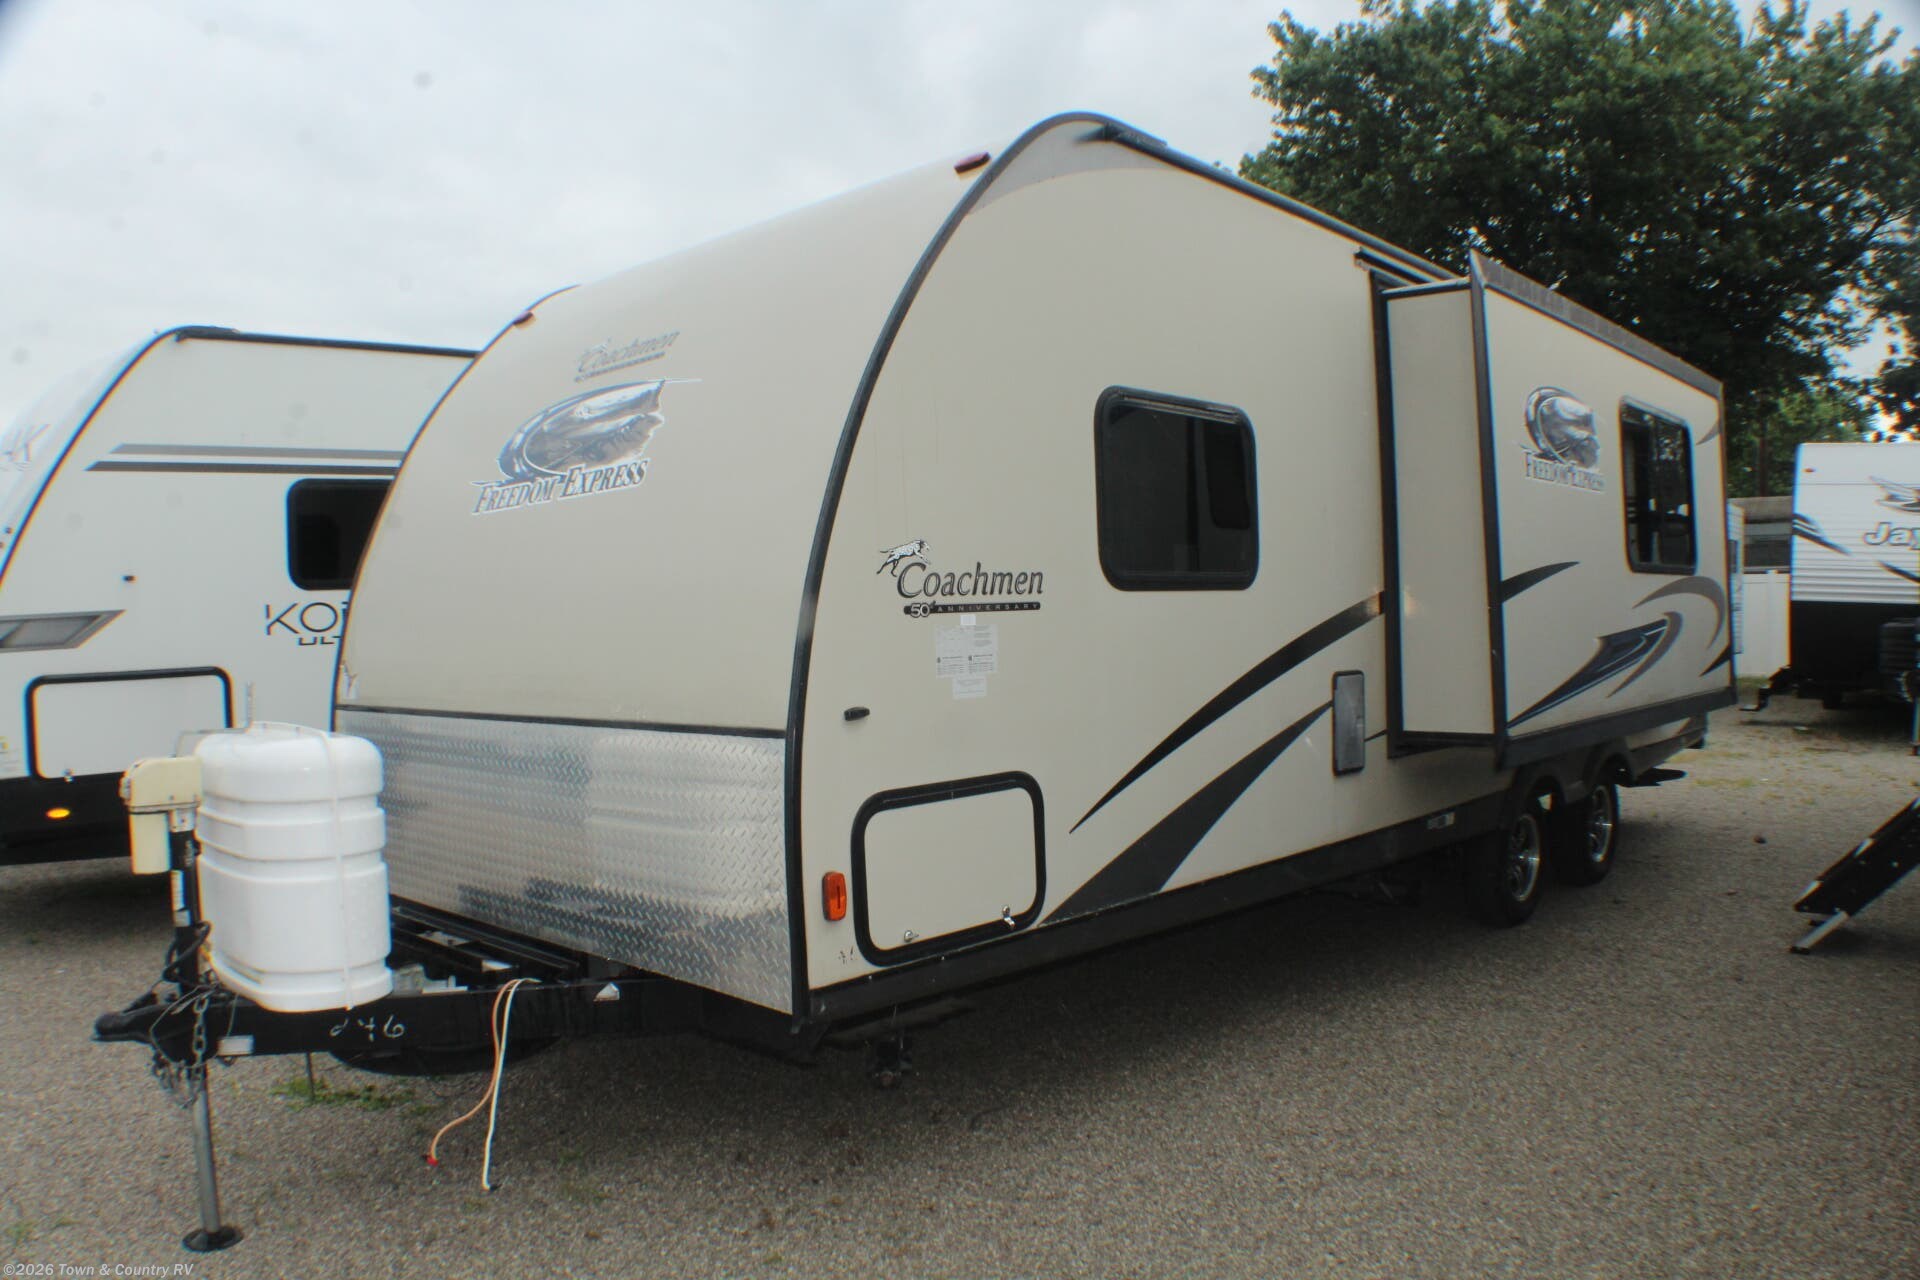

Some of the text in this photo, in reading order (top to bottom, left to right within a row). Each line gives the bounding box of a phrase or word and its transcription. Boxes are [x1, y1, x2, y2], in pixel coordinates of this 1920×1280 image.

[472, 459, 649, 513] FREEDOM EXPRESS
[897, 561, 1043, 598] Coachmen
[264, 601, 349, 636] KO
[938, 603, 1038, 612] ANNIVERSARY
